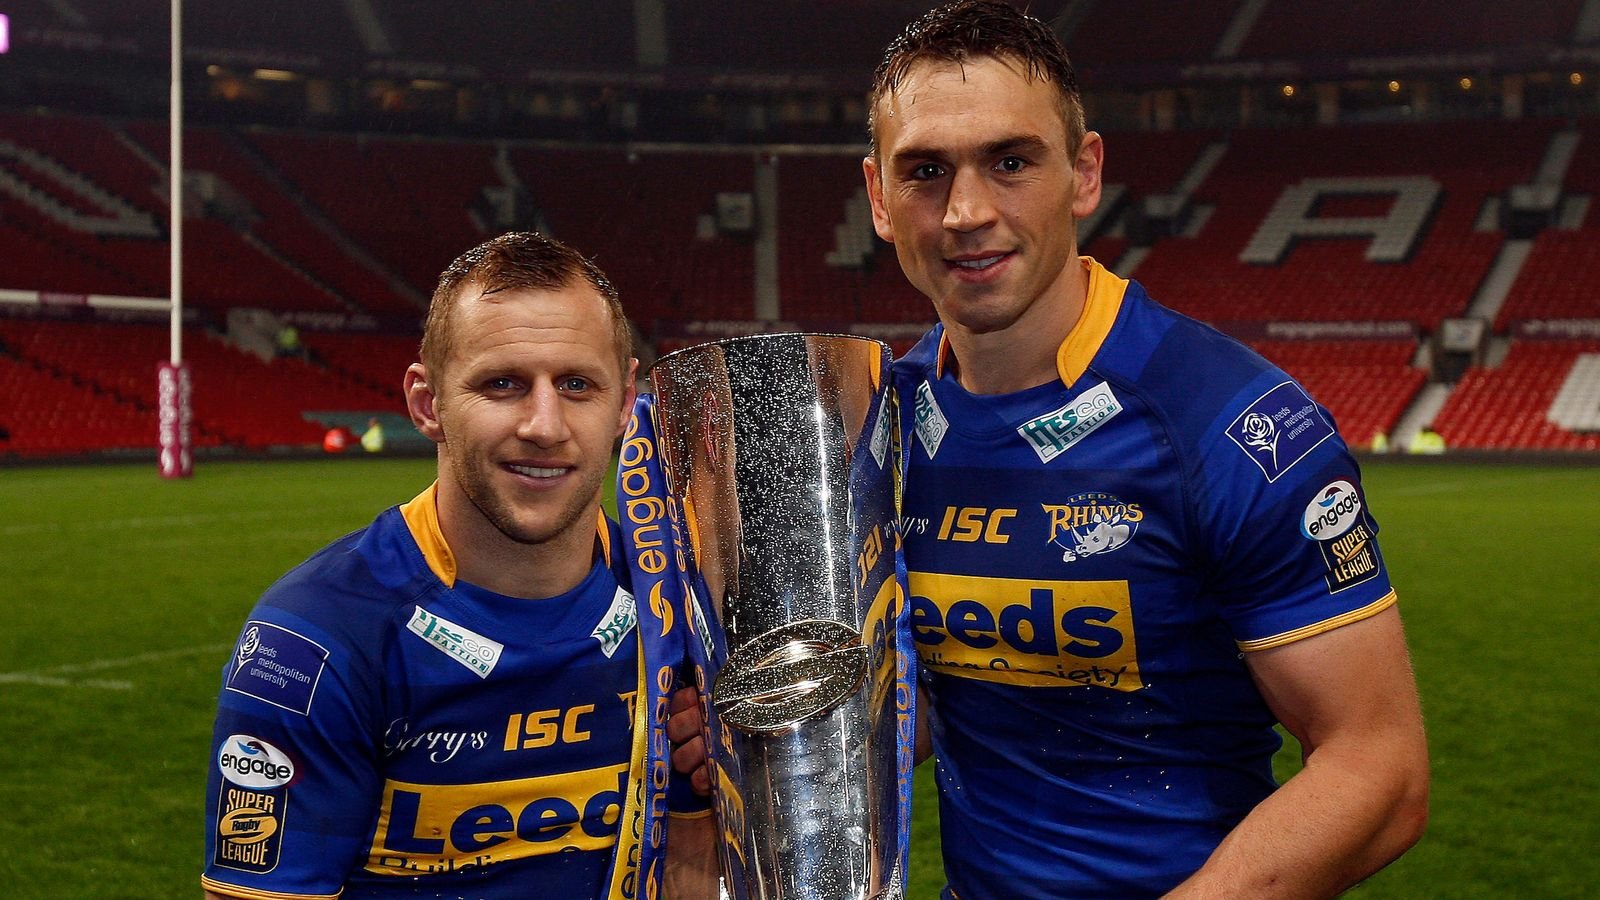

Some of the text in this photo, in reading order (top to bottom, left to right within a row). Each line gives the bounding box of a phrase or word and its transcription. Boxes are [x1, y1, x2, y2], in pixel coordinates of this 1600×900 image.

[1062, 404, 1115, 443] BASTION
[1070, 493, 1117, 503] LEEDS
[1309, 490, 1359, 536] engage
[937, 506, 1018, 544] ISC
[1331, 525, 1369, 565] SUPER
[1334, 547, 1375, 583] LEAGUE
[909, 588, 1124, 659] eeds
[257, 657, 311, 684] metropolitan
[431, 633, 489, 673] BASTION
[250, 667, 289, 689] university
[989, 657, 1127, 687] Siety
[503, 704, 595, 751] ISC
[221, 753, 291, 780] engage
[226, 789, 275, 814] SUPER
[384, 770, 629, 855] Leed
[222, 839, 269, 866] LEAGUE
